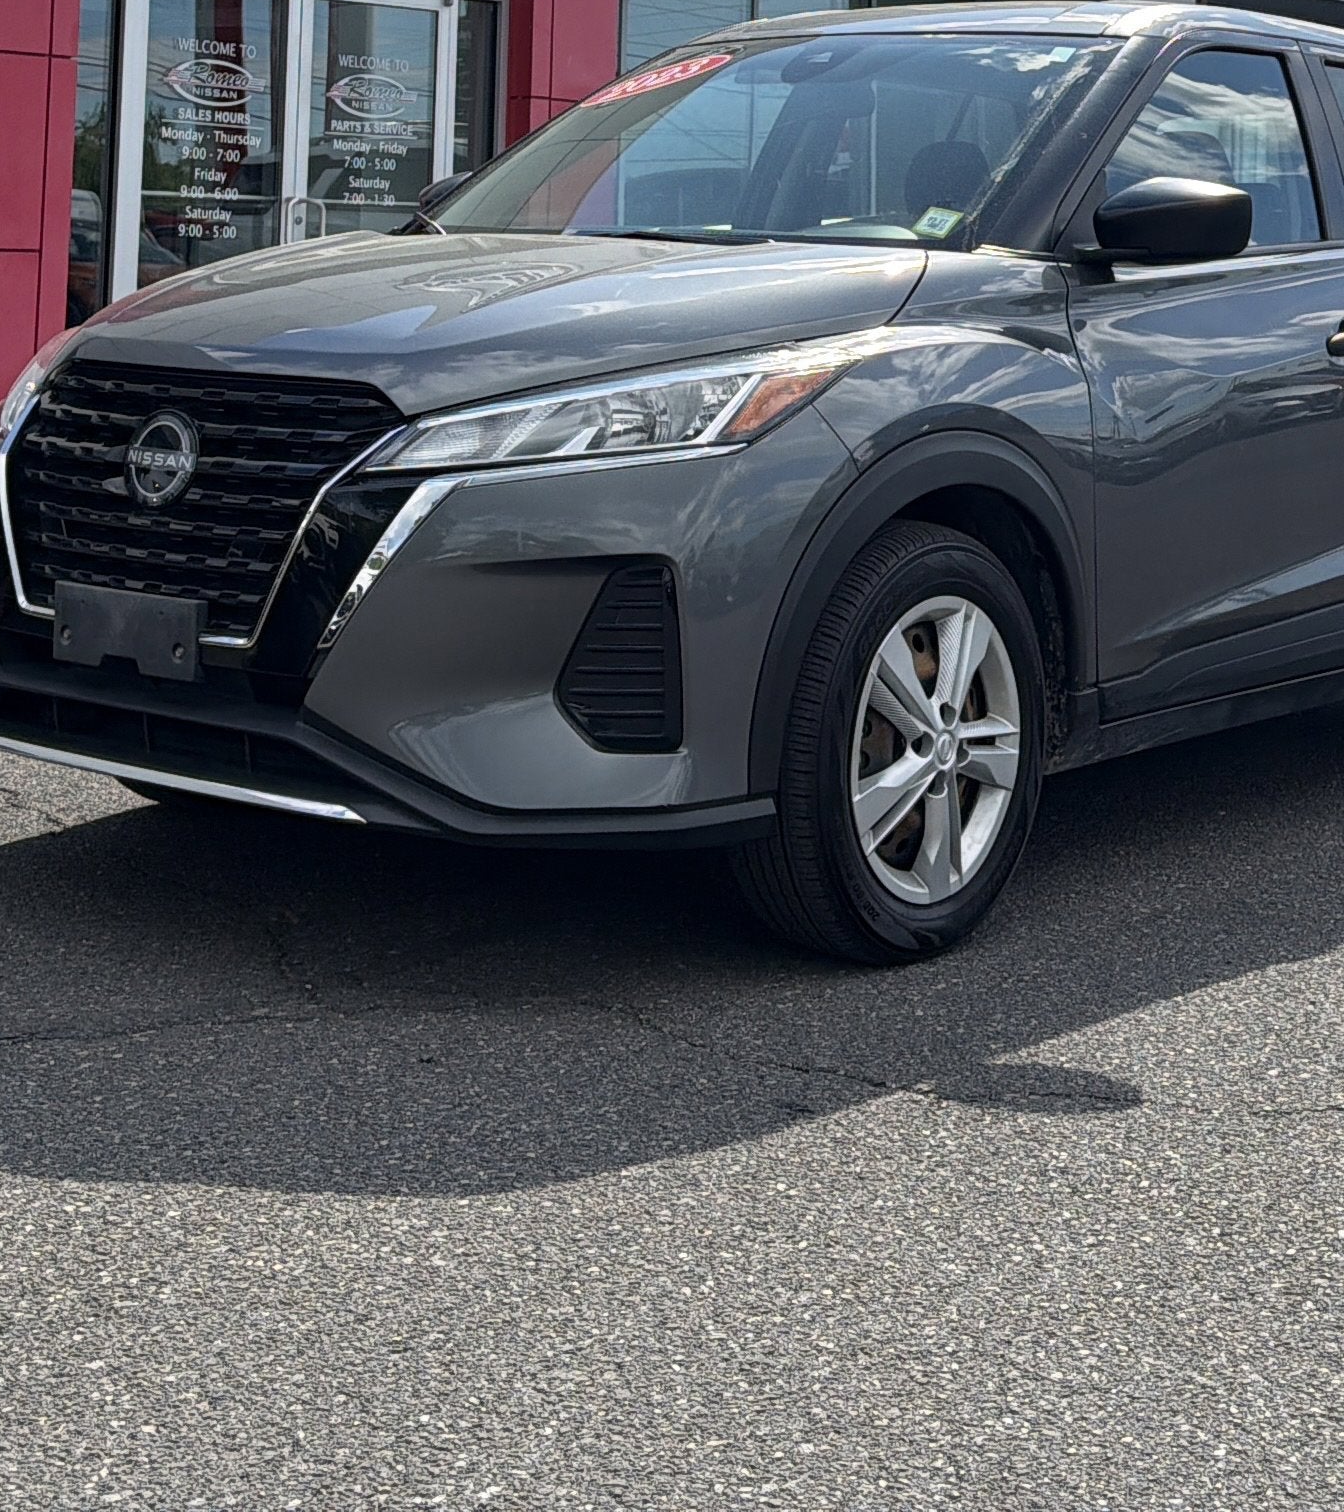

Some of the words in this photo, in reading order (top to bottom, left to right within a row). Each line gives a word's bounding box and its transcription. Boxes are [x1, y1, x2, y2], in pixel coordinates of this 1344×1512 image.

[177, 37, 237, 58] WELCOME
[238, 44, 257, 59] TO
[338, 53, 391, 71] WELCOME
[394, 59, 409, 72] TO
[189, 61, 250, 88] Romeo
[192, 87, 238, 99] NISSAN
[347, 78, 404, 99] Romeo
[351, 100, 393, 112] NISSAN
[177, 107, 212, 122] SALES
[214, 110, 251, 125] HOURS
[330, 119, 362, 133] PARTS
[363, 122, 373, 133] &
[375, 122, 414, 136] SERVICE
[161, 126, 205, 144] Monday
[213, 129, 262, 148] Thursday
[181, 146, 207, 160] 9:00
[216, 148, 241, 163] 7:00
[332, 139, 372, 155] Monday
[378, 141, 409, 158] Friday
[343, 156, 366, 169] 7:00
[374, 157, 397, 171] 5:00
[193, 167, 228, 185] Friday
[348, 175, 391, 192] Saturday
[180, 184, 205, 199] 9:00
[213, 186, 239, 201] 6:00
[342, 192, 365, 205] 7:00
[374, 193, 396, 207] 1:30
[184, 205, 233, 223] Saturday
[177, 223, 203, 237] 9:00
[212, 225, 237, 239] 5:00
[127, 448, 193, 468] NISSAN
